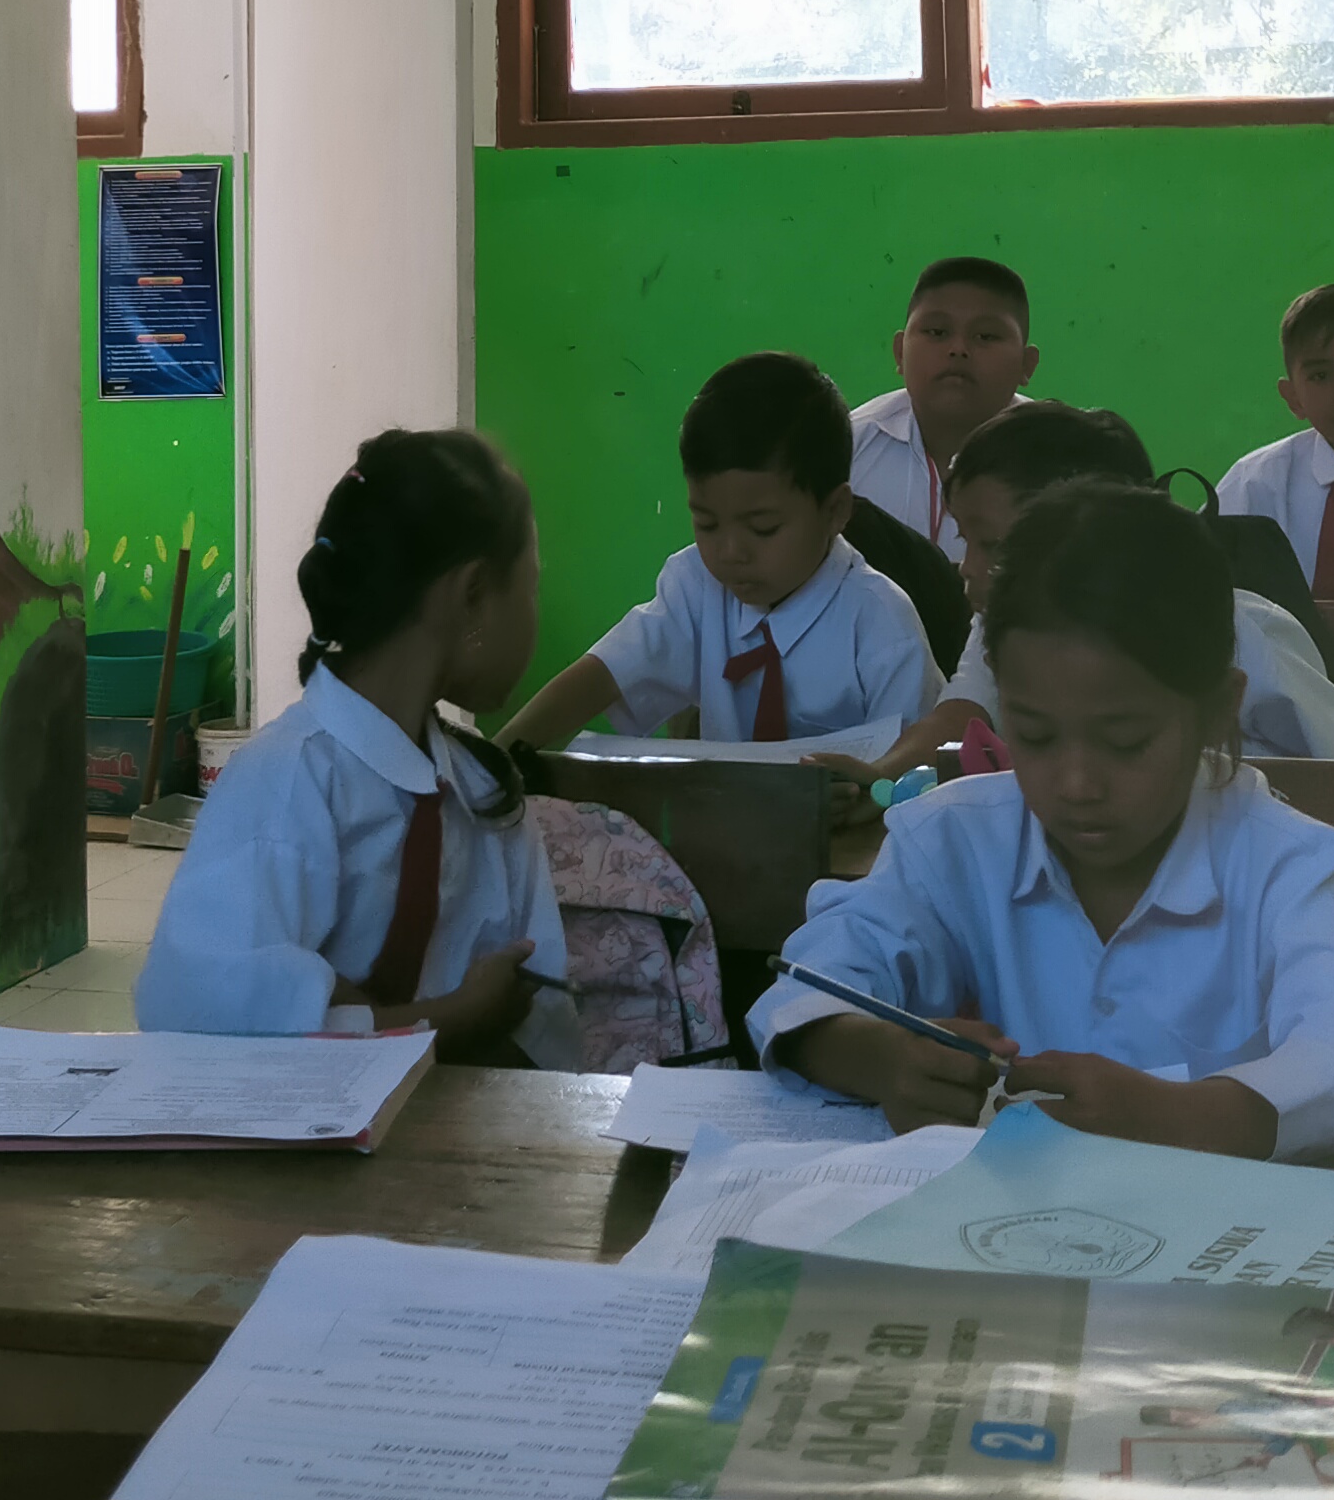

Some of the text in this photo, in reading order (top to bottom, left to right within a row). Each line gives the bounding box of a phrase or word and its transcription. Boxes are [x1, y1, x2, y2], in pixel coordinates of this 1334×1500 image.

[1187, 1225, 1266, 1275] SISWA
[1227, 1260, 1282, 1286] AN
[980, 1431, 1047, 1451] 2
